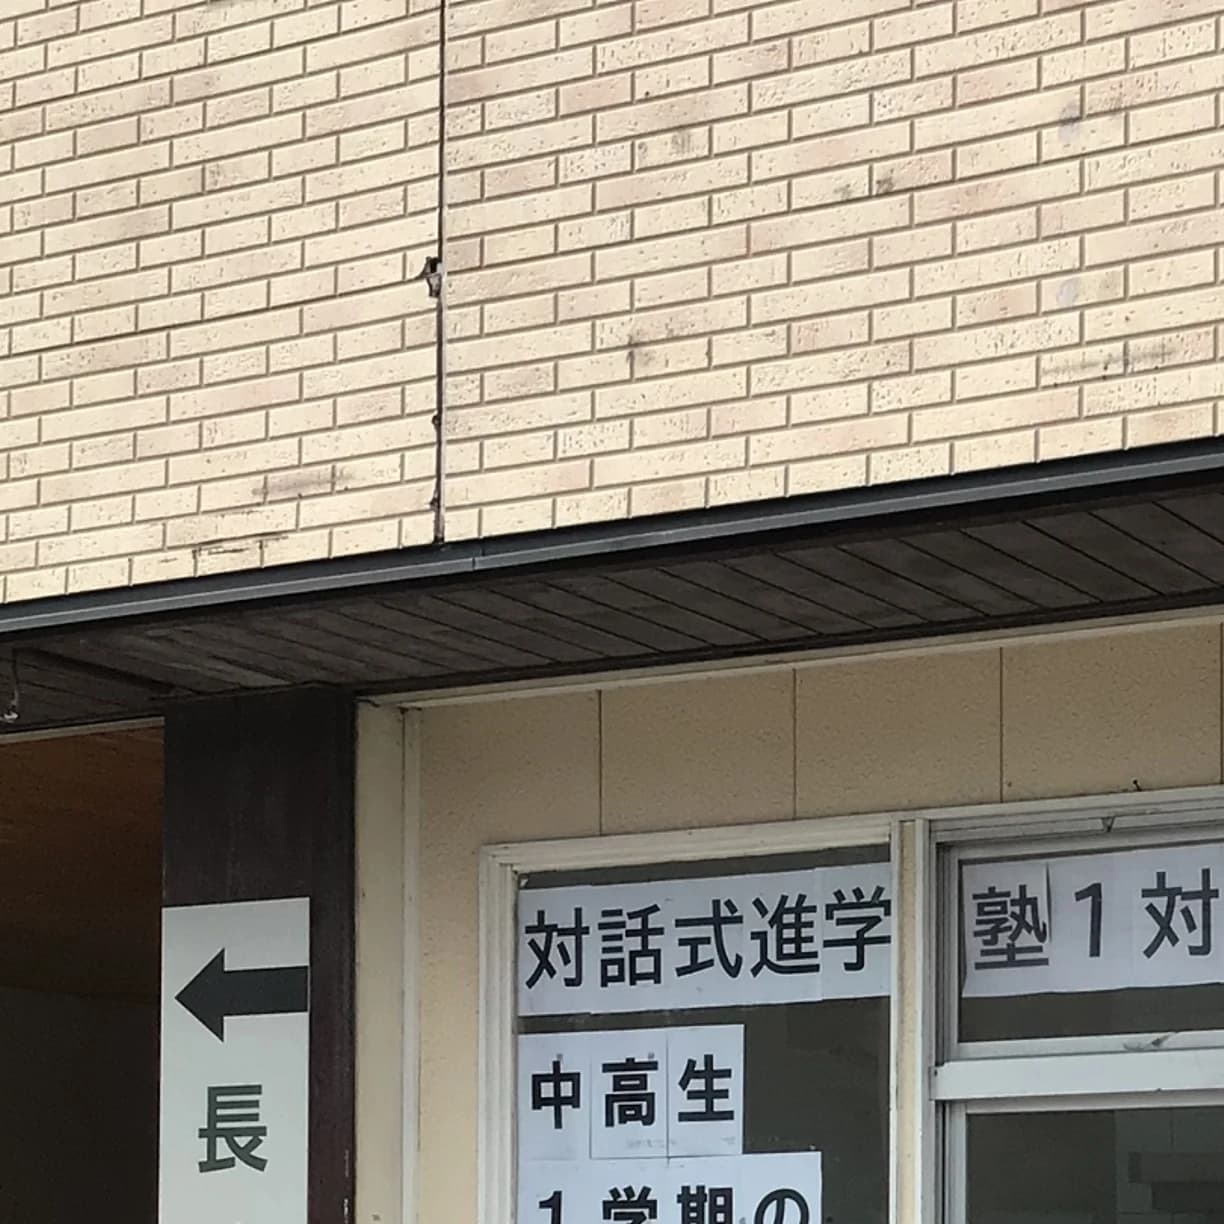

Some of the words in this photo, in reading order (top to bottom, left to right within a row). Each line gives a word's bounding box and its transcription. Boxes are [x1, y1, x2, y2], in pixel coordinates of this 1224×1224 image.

[525, 885, 891, 989] 対話式進学
[532, 1054, 734, 1129] 中高生
